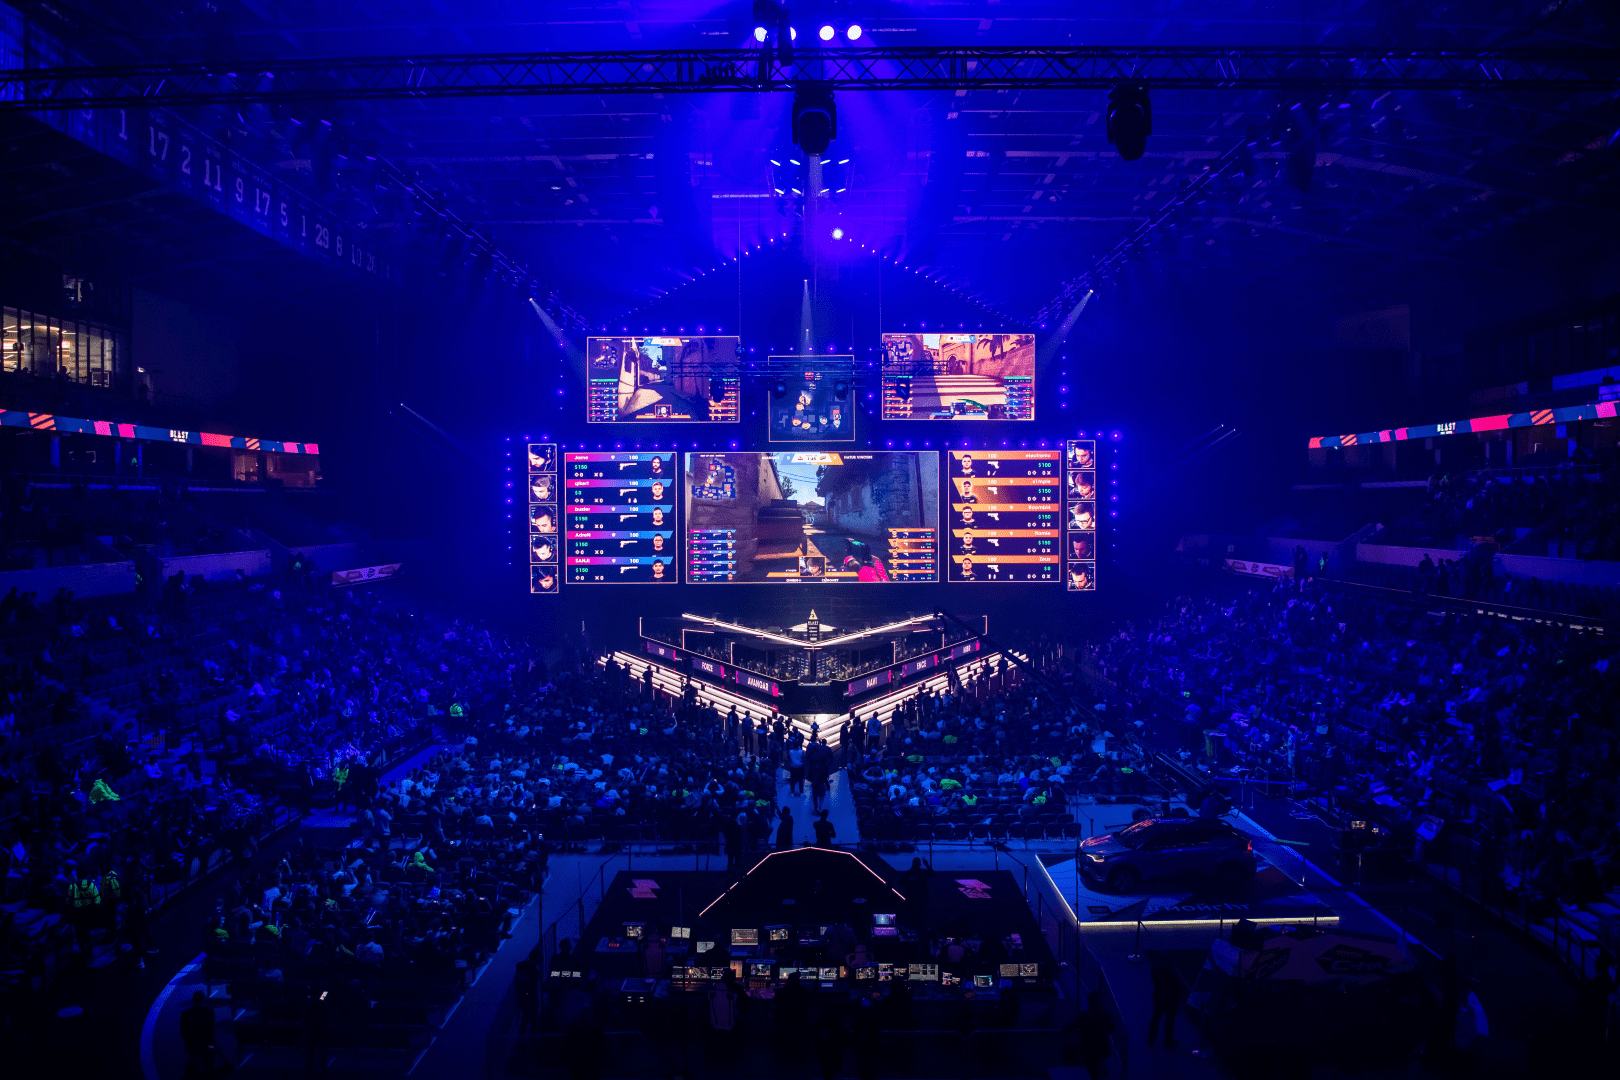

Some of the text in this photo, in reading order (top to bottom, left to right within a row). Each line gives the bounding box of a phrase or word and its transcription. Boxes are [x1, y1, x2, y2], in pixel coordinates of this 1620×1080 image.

[119, 109, 128, 140] 1
[149, 126, 170, 160] 17
[181, 145, 191, 175] 2
[203, 159, 222, 191] 11
[235, 176, 244, 203] 9
[254, 188, 271, 217] 17
[280, 202, 288, 227] 5
[301, 215, 307, 237] 1
[315, 223, 329, 249] 29
[336, 235, 343, 257] 8
[169, 429, 189, 440] BLAST
[1437, 422, 1456, 432] BLAST
[916, 660, 927, 670] ENCE
[747, 677, 769, 691] AVANGAR
[866, 676, 878, 688] NAVI
[1335, 949, 1363, 958] TOYOTA
[1330, 960, 1383, 971] C-HR
